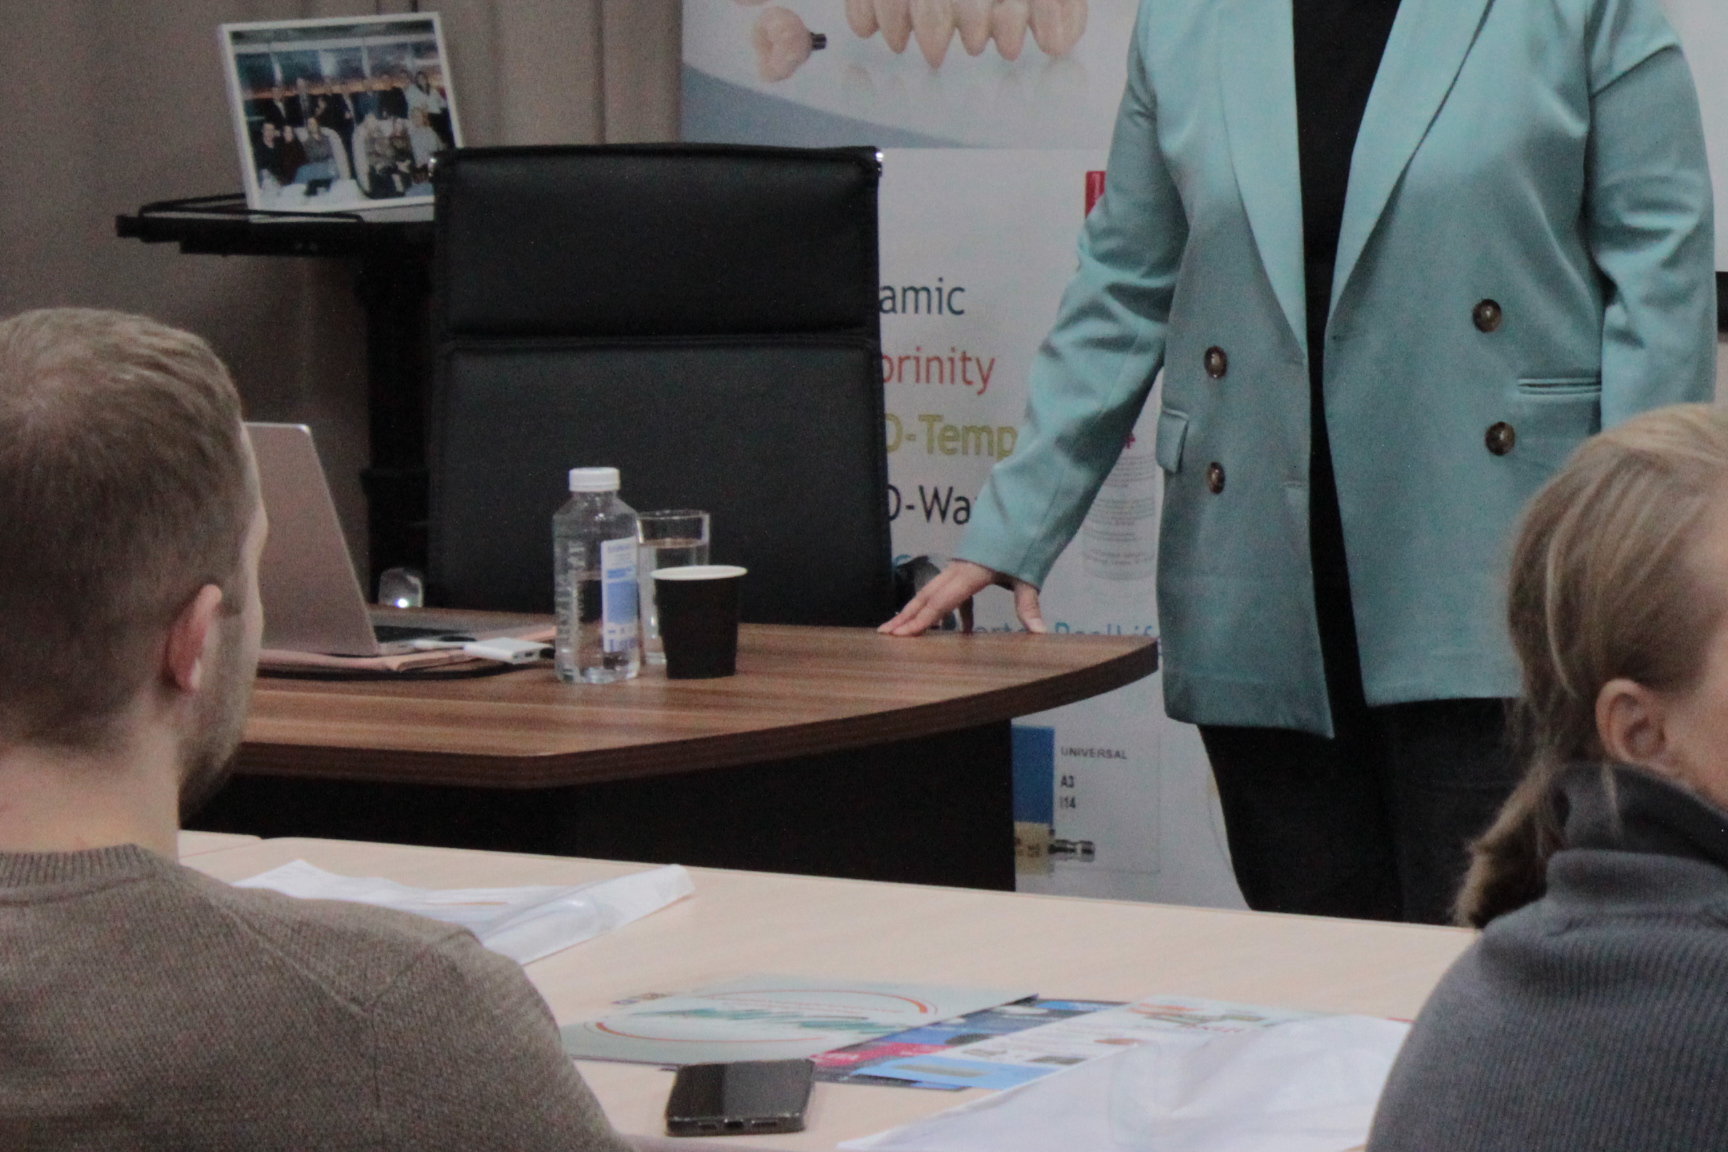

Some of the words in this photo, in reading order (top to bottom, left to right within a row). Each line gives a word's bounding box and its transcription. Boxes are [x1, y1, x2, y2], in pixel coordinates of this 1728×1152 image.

[880, 277, 965, 316] amic
[885, 413, 1017, 462] D-Temp
[1061, 747, 1127, 760] UNIVERSAL
